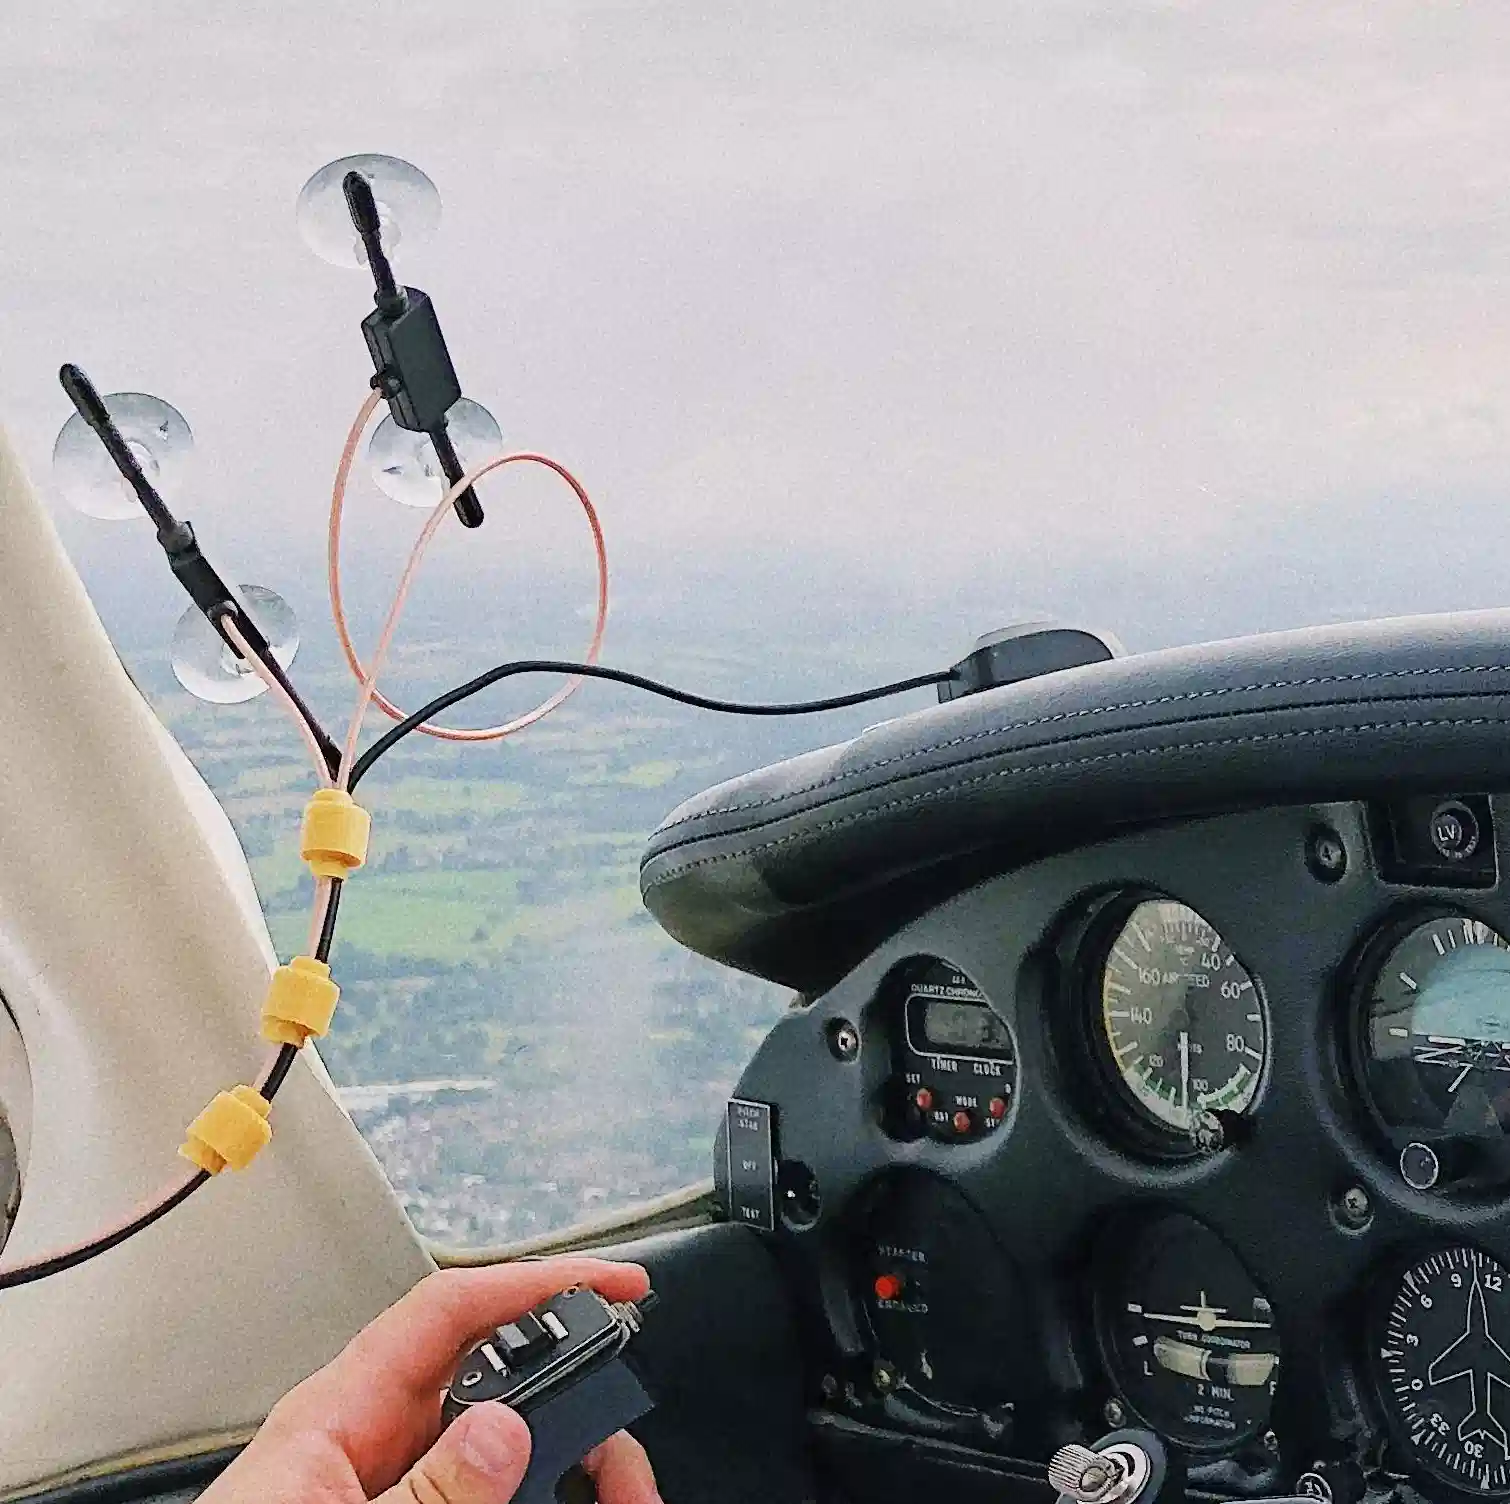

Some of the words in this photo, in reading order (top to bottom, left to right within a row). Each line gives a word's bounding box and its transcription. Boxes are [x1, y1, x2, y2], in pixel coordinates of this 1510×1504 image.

[1437, 823, 1456, 841] LV
[1221, 982, 1240, 1000] 60
[1226, 1034, 1245, 1052] 80
[973, 1062, 1002, 1077] CLOCK
